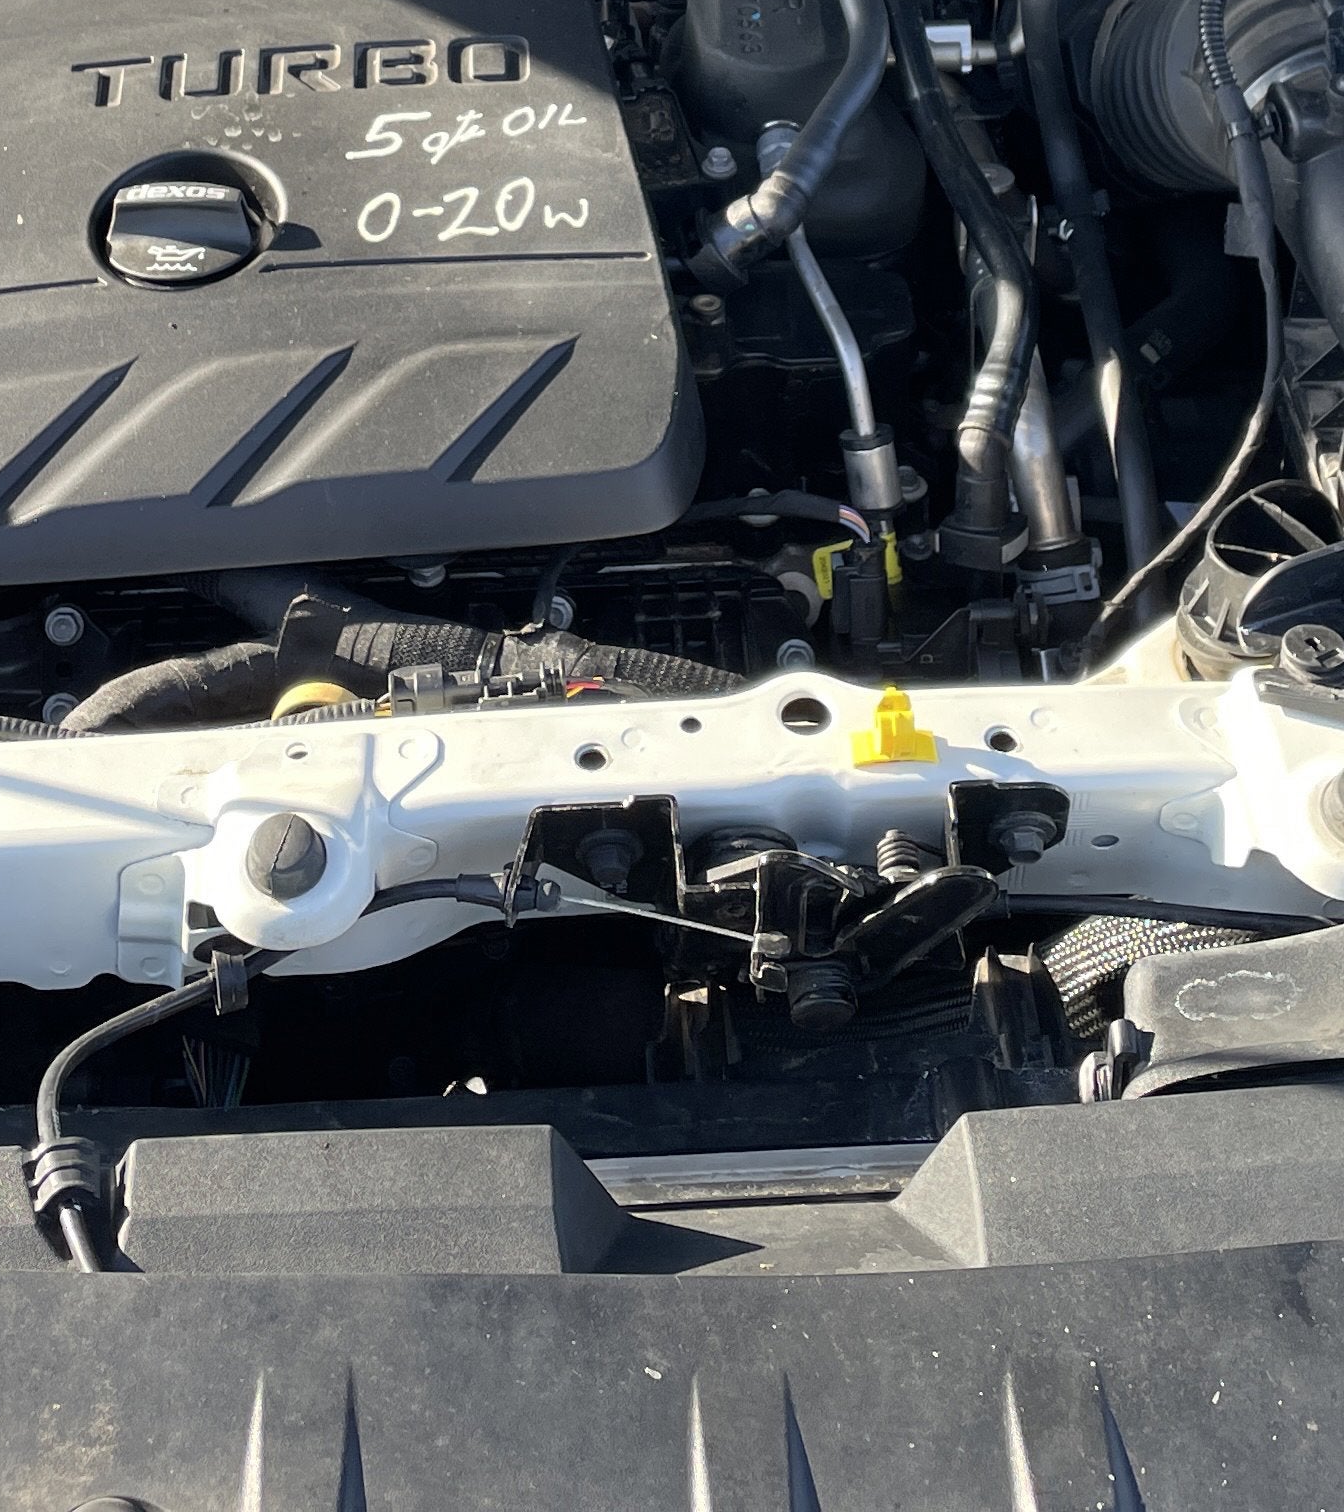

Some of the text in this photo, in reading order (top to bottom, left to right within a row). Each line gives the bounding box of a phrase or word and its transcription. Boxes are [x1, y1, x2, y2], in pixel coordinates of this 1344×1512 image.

[71, 34, 531, 107] TURBO
[345, 111, 431, 160] 5
[503, 103, 587, 136] OIL
[126, 184, 227, 200] dexos
